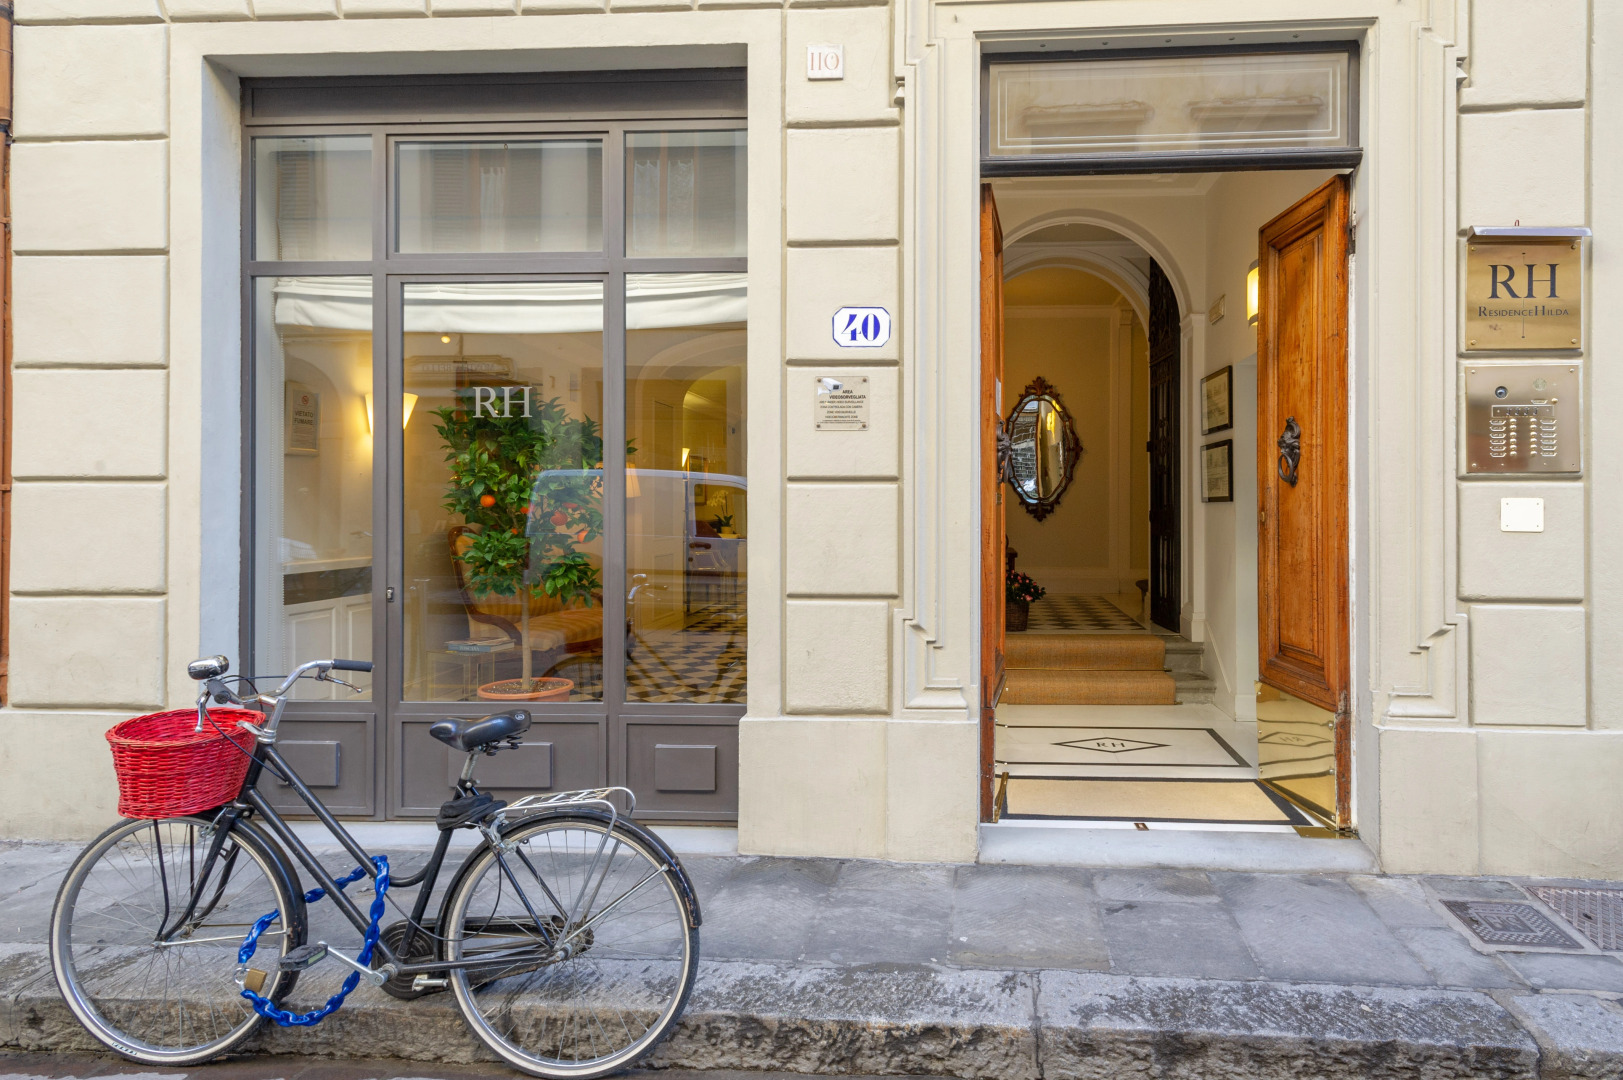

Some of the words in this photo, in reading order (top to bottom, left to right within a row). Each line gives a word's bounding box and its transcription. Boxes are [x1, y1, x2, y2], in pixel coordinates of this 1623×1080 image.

[810, 52, 840, 71] 110
[1487, 263, 1560, 299] RH
[841, 313, 881, 341] 40
[294, 410, 314, 418] VIETATO
[472, 386, 533, 418] RH
